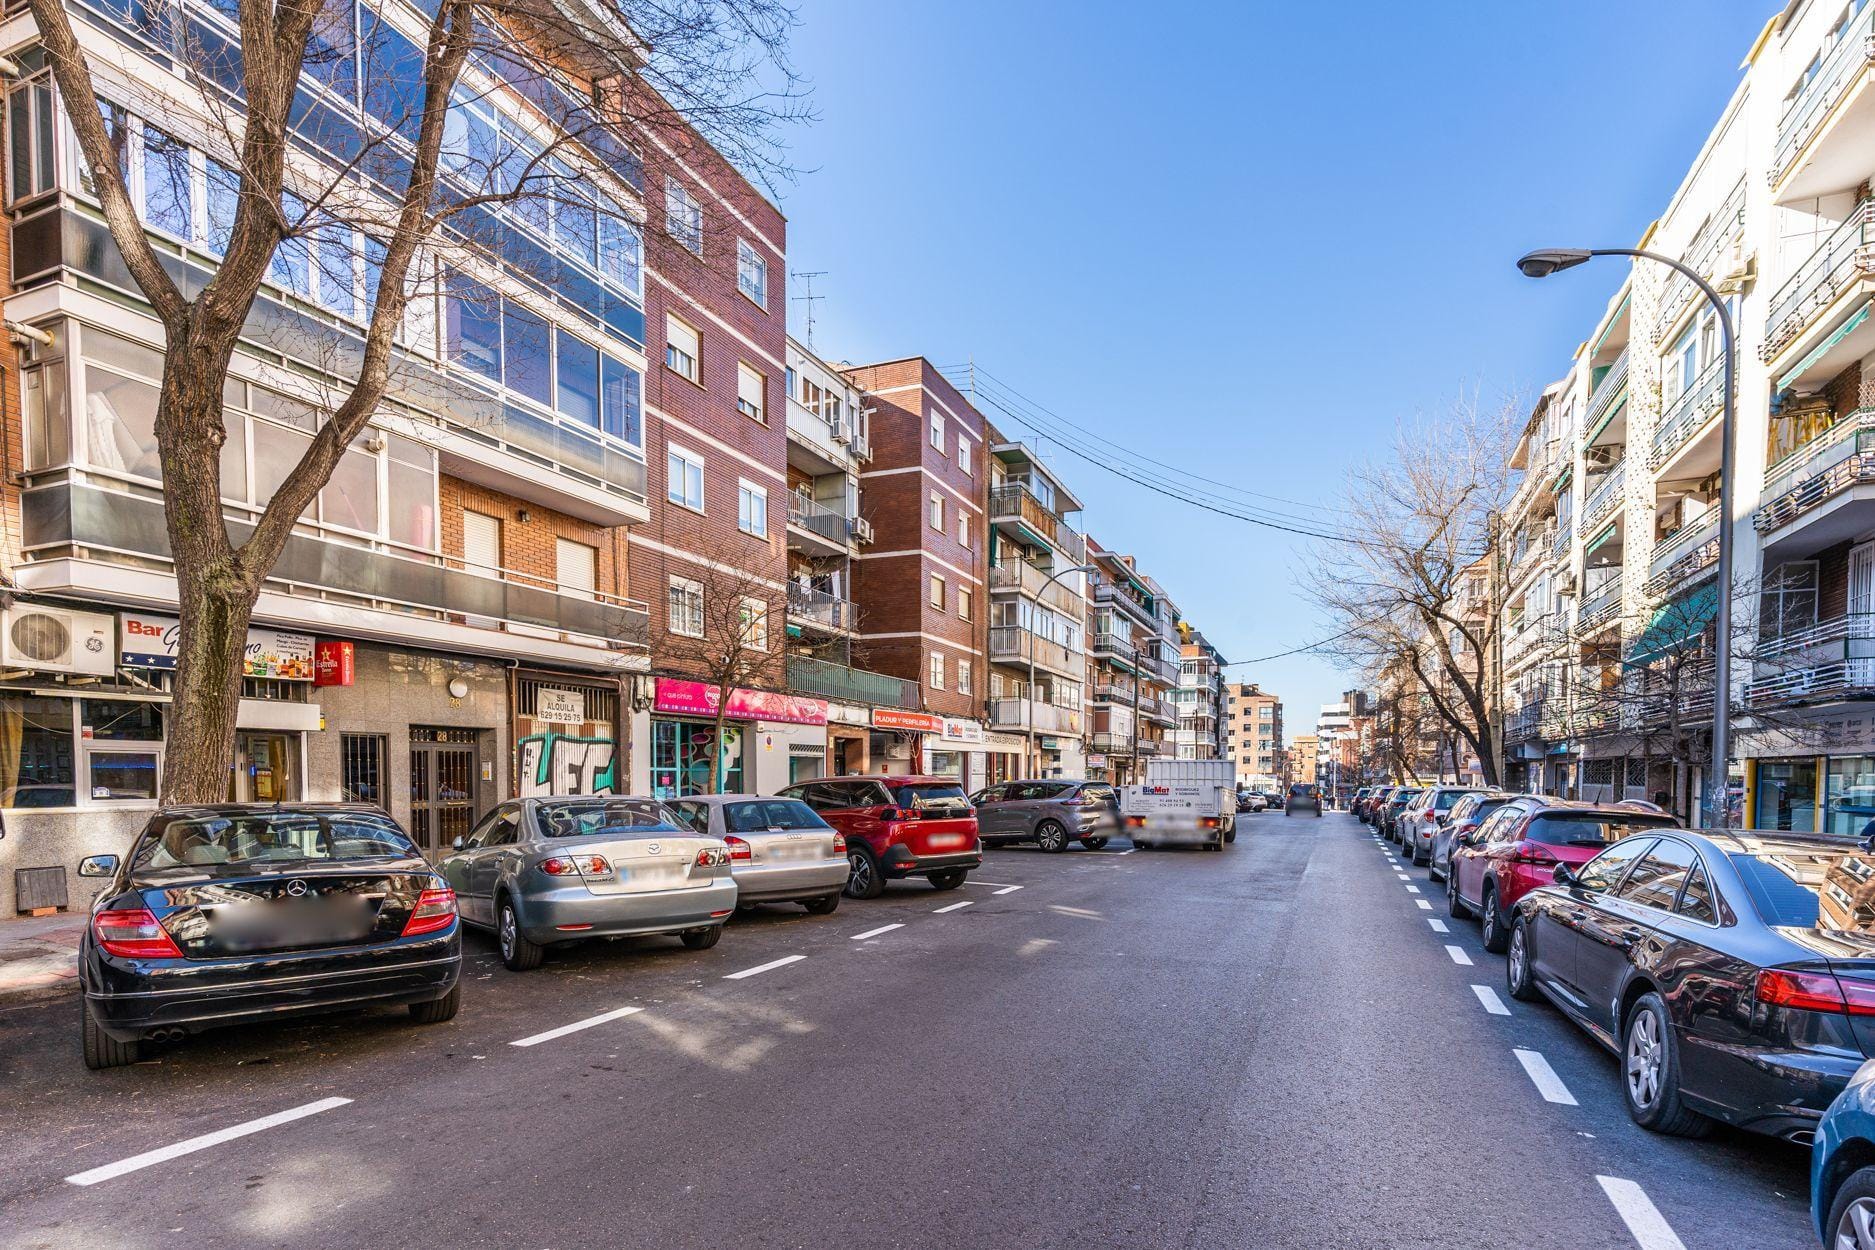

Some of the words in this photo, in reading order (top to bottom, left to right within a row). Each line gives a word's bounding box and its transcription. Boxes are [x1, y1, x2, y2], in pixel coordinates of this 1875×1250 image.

[127, 620, 164, 637] Bar
[316, 659, 338, 668] Estrella
[556, 694, 565, 702] SE
[547, 702, 575, 712] ALQUILA
[540, 711, 553, 720] 629
[555, 712, 563, 720] 15
[573, 714, 581, 722] 75
[875, 715, 897, 723] PLADUR
[437, 731, 447, 741] 28
[1142, 786, 1170, 794] BigMat
